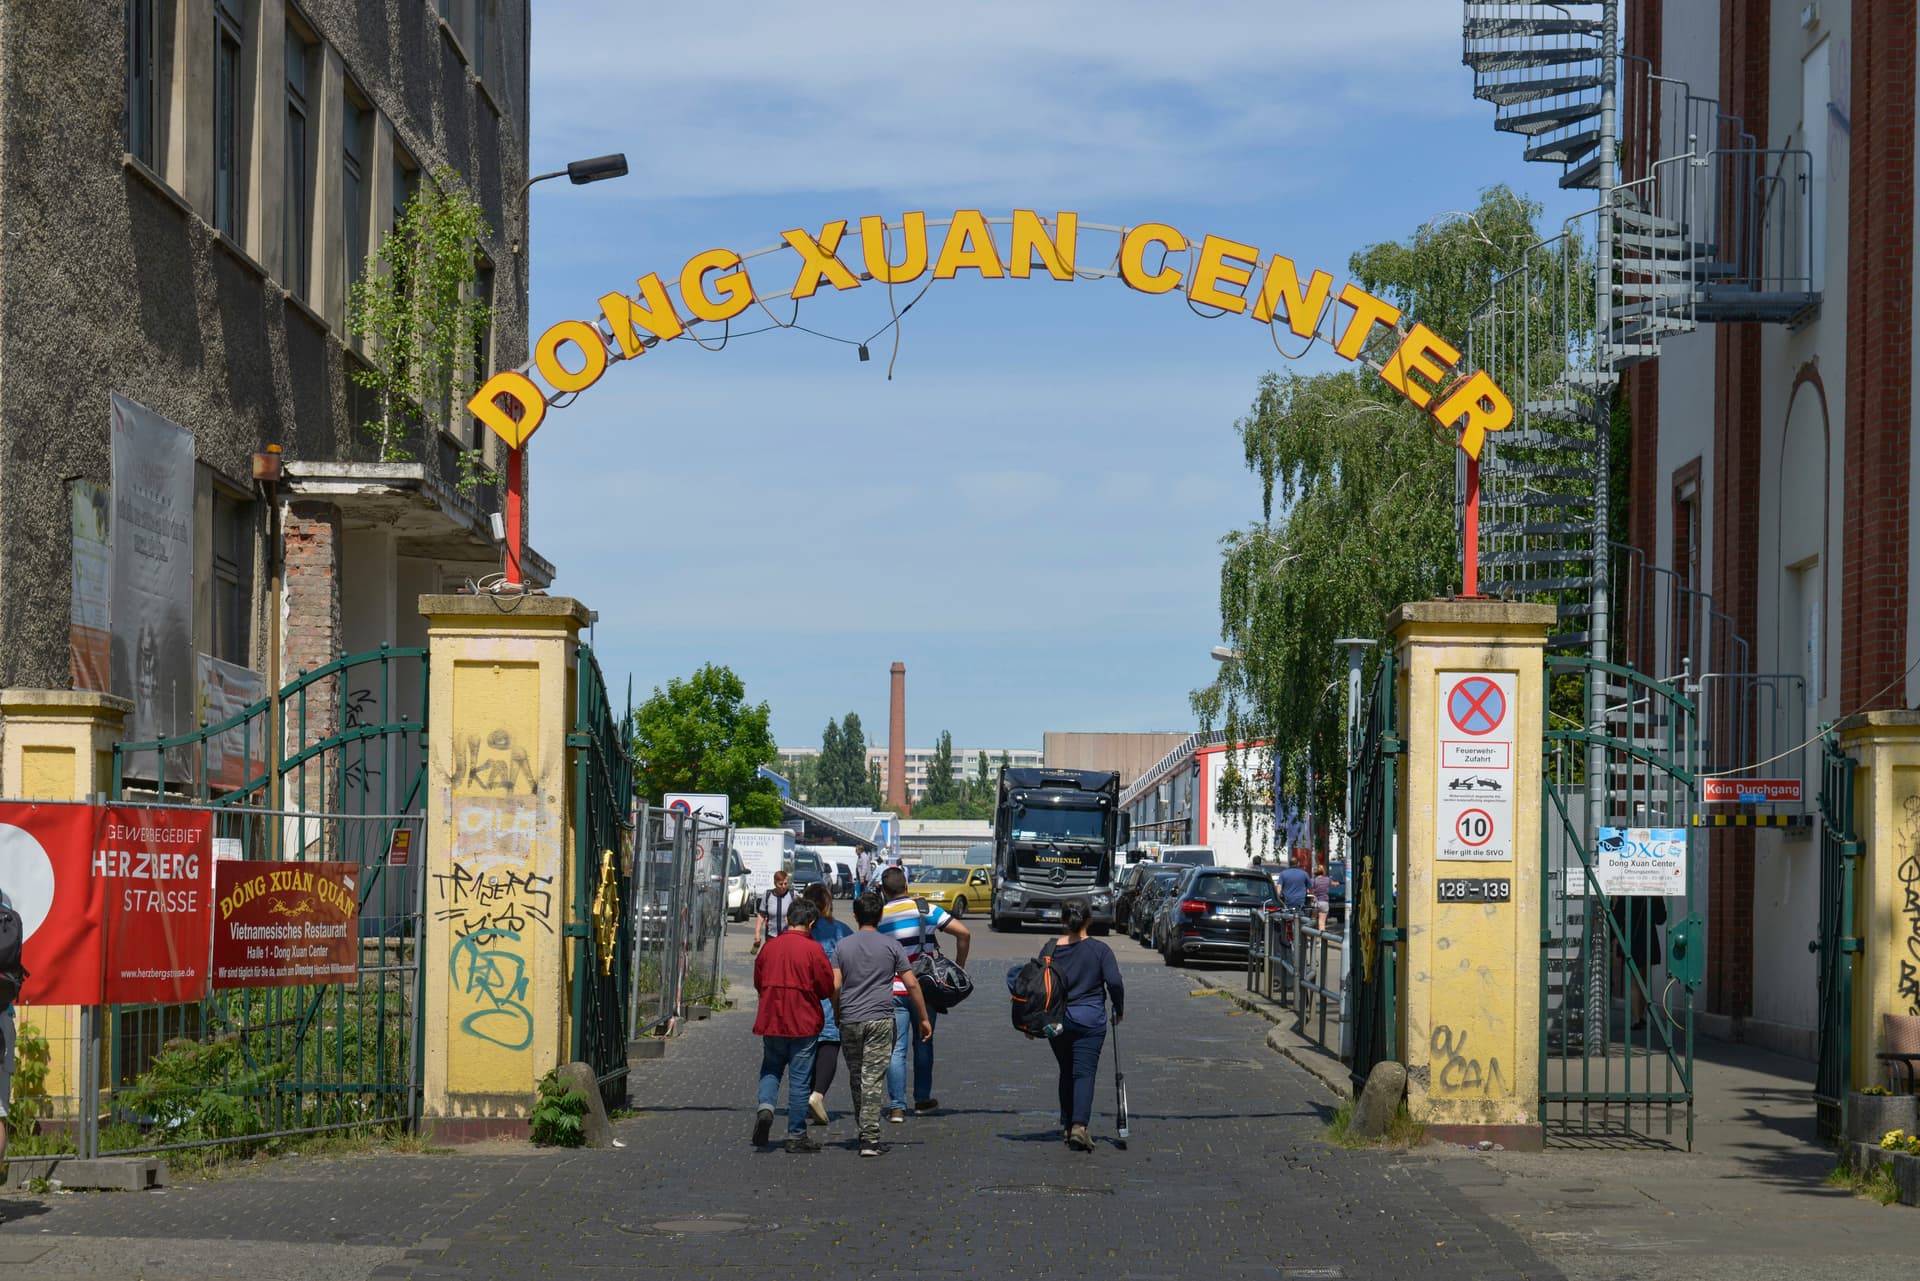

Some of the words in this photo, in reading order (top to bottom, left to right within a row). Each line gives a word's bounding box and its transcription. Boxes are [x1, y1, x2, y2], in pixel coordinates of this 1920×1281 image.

[467, 248, 755, 450] DONG
[780, 209, 1077, 300] XUAN
[1118, 222, 1514, 462] CENTER
[1455, 746, 1496, 754] Feuerwehr-
[1464, 755, 1491, 763] Zufahrt
[1707, 783, 1733, 794] Kein
[1736, 783, 1800, 796] Durchgang
[108, 824, 202, 844] GEWERBEGEBIET
[1461, 817, 1487, 837] 10
[1035, 855, 1082, 864] KAMPHENKEL
[1444, 848, 1459, 856] Hier
[1460, 848, 1472, 857] gilt
[1473, 848, 1485, 856] die
[1485, 849, 1504, 857] StVO
[92, 849, 199, 880] HERZBERG
[1608, 859, 1629, 868] Dong
[1631, 859, 1650, 867] Xuan
[1651, 859, 1676, 867] Center
[123, 889, 198, 913] STRASSE
[230, 921, 303, 940] Vietnamesisches
[304, 921, 347, 939] Restaurant
[247, 945, 264, 960] Halle
[274, 945, 291, 961] Dong
[291, 944, 308, 958] Xuan
[308, 944, 329, 957] Center
